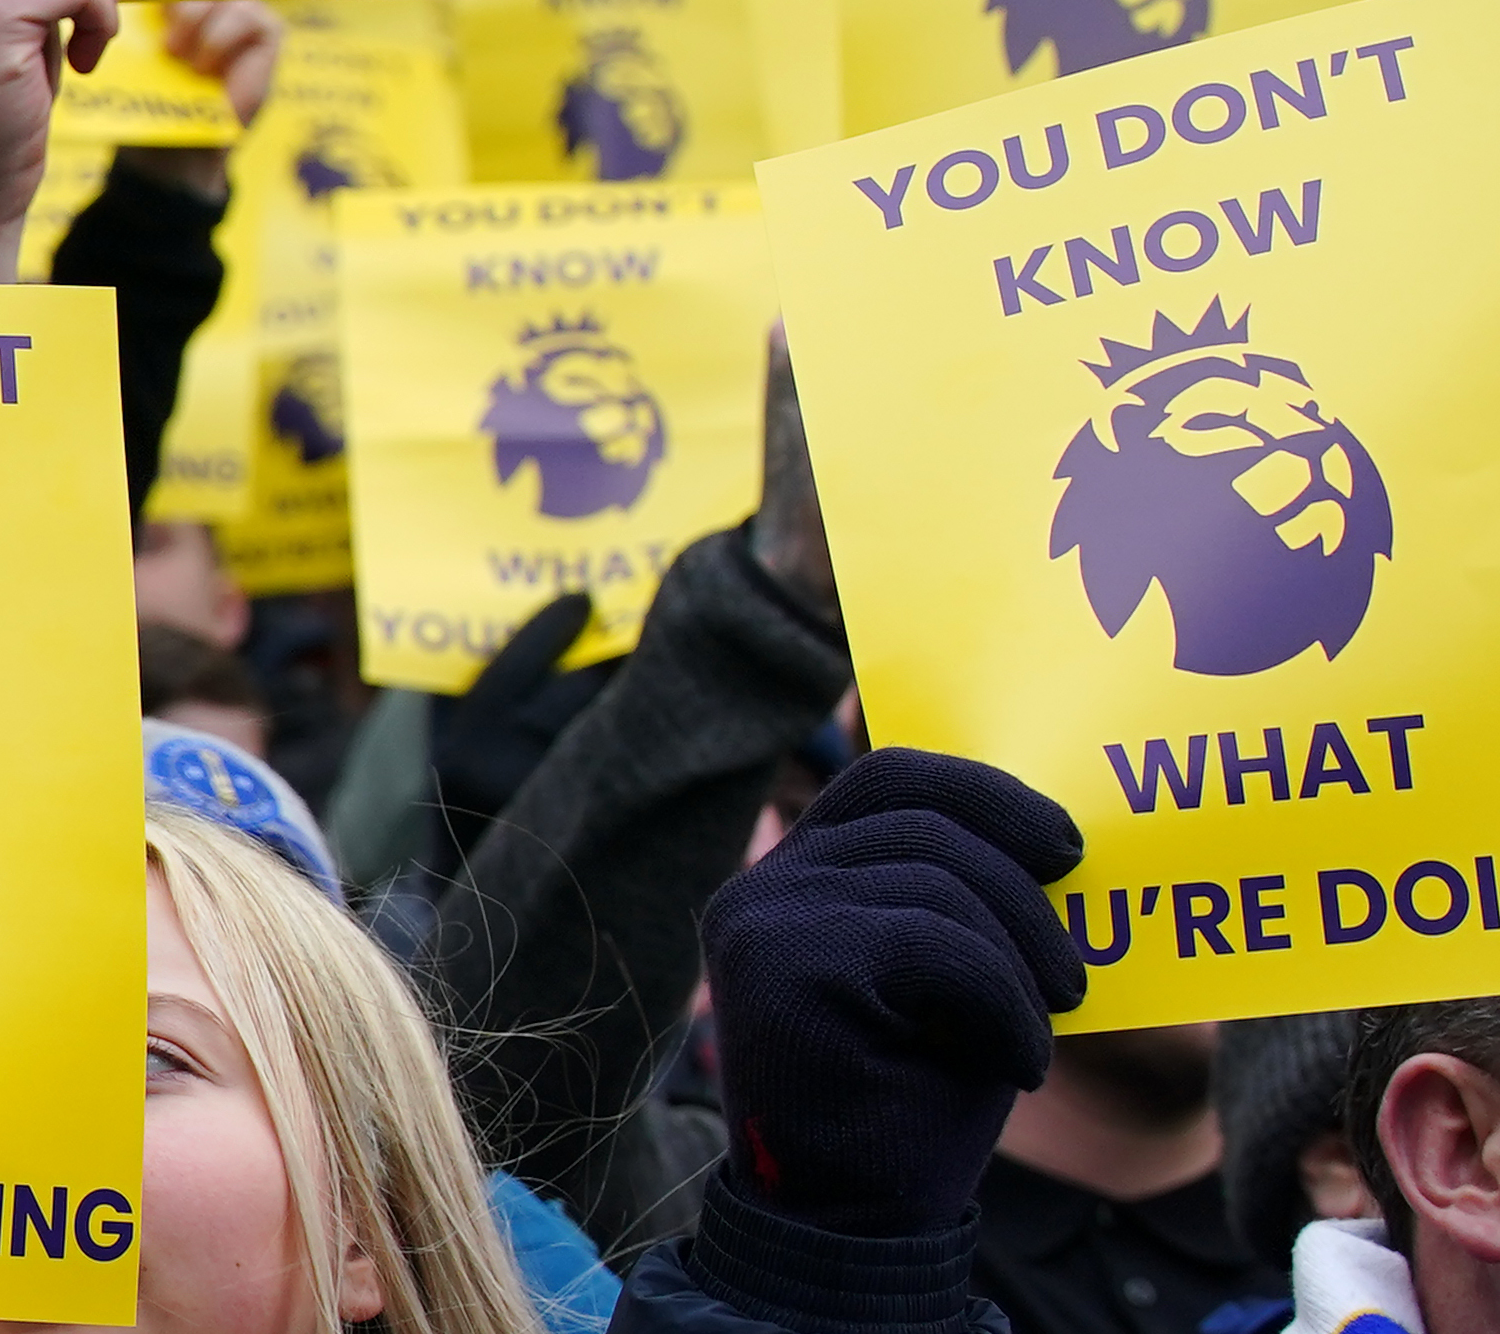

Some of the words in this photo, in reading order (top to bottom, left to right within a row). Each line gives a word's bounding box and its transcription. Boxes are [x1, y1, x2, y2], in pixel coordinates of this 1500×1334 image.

[853, 124, 1069, 230] YOU
[1094, 35, 1415, 171] DON'T
[401, 204, 520, 229] YOU
[992, 179, 1324, 317] KNOW
[466, 252, 656, 294] KNOW
[1104, 715, 1424, 814] WHAT
[1065, 873, 1292, 967] U'RE
[1318, 856, 1500, 944] DOI
